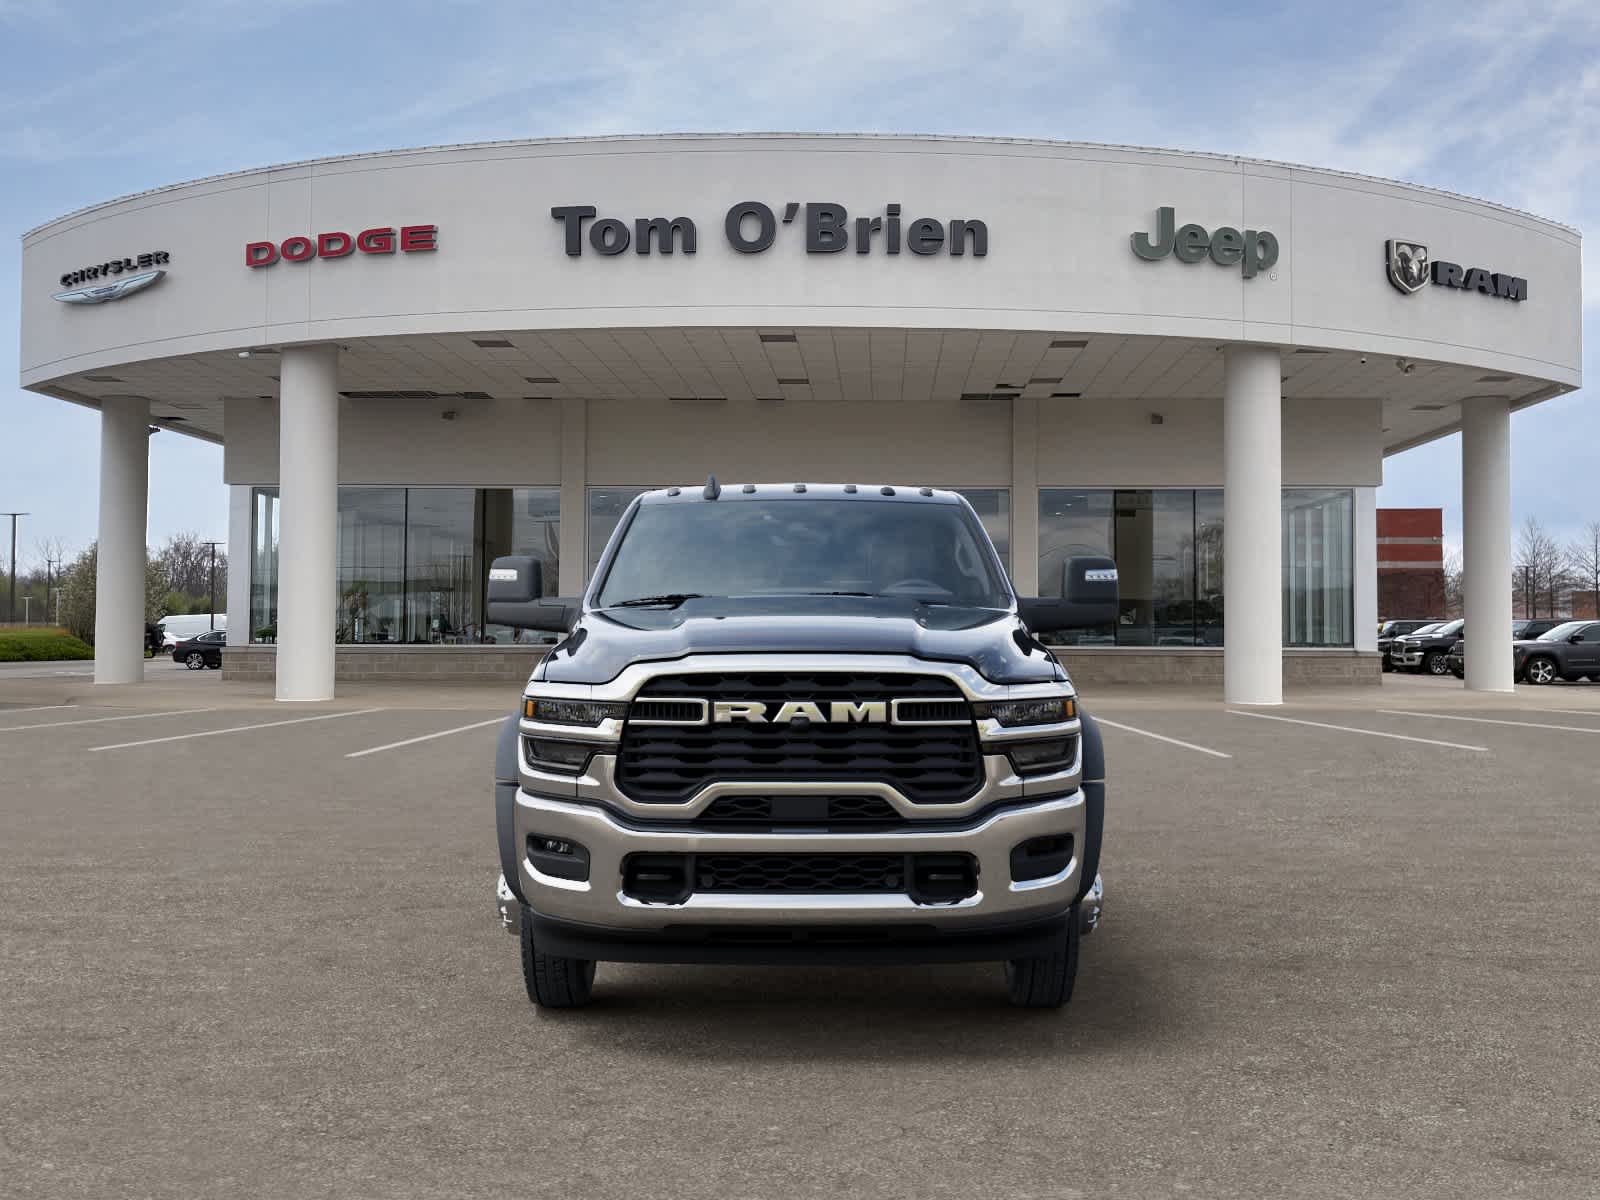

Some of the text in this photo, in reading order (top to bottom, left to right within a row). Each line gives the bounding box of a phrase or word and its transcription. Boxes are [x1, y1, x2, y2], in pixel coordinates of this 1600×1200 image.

[246, 225, 437, 269] DODGE
[551, 201, 988, 256] Tom O'Brien
[1130, 206, 1280, 279] Jeep
[60, 250, 170, 287] CHRYSLER
[1431, 261, 1528, 301] RAM
[714, 701, 887, 723] RAM
